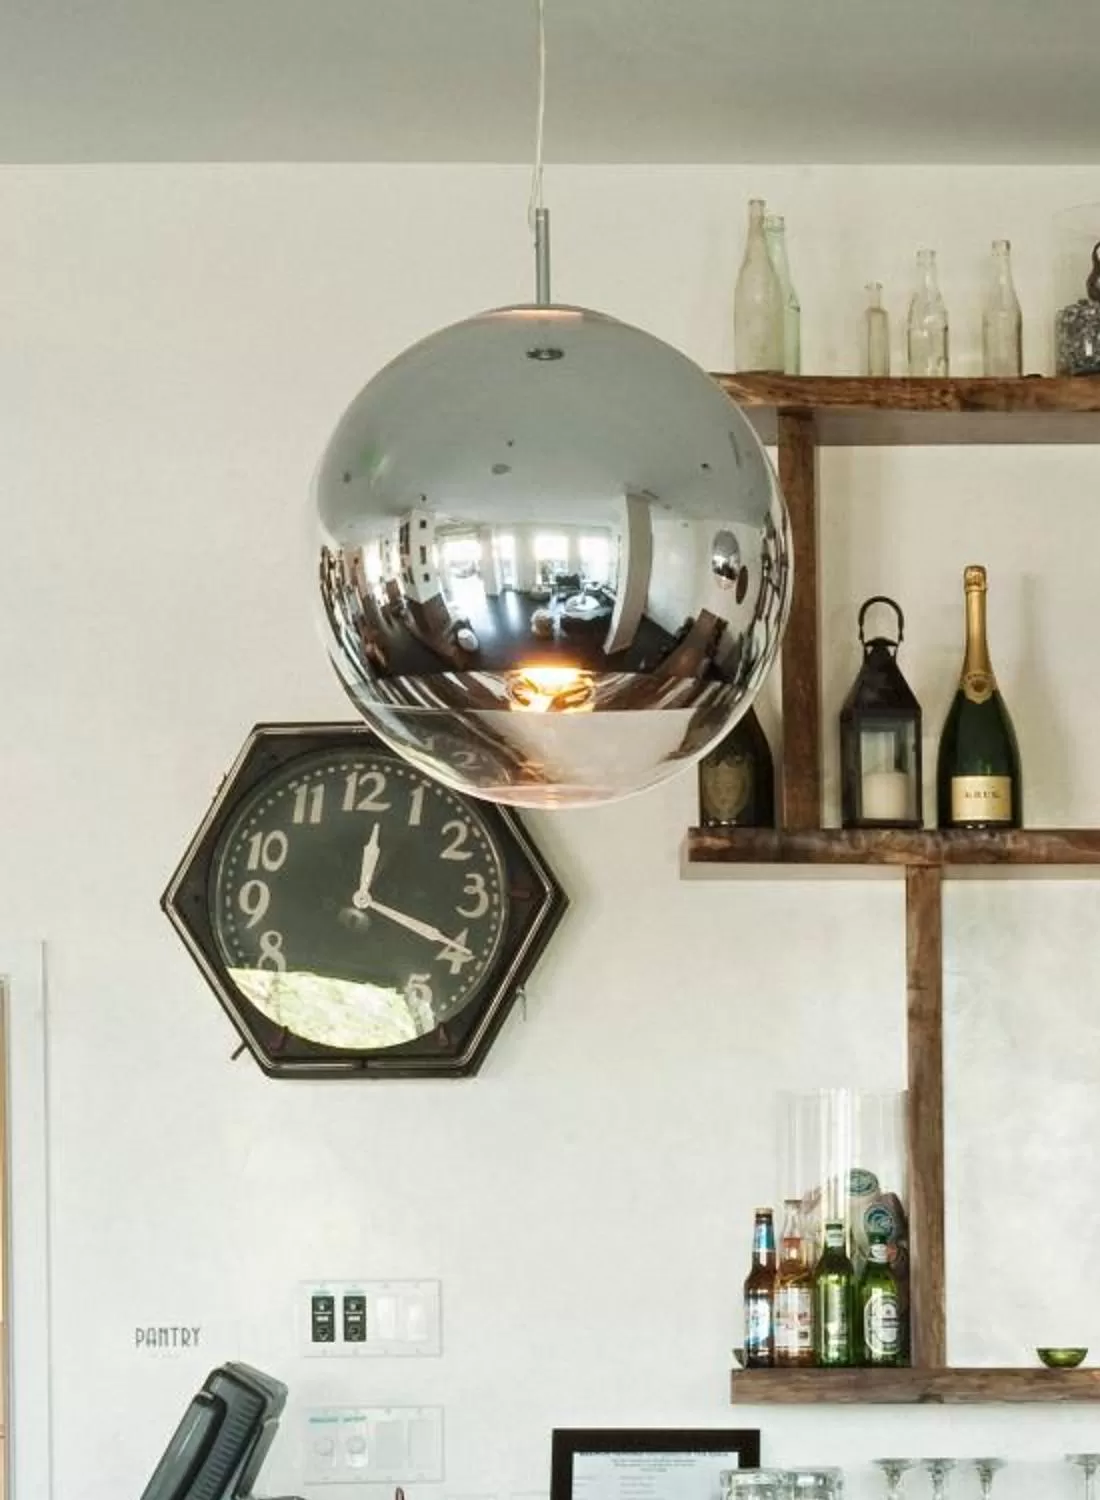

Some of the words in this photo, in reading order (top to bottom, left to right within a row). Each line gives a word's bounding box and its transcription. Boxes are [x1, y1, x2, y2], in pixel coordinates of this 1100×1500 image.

[292, 783, 325, 825] 11
[341, 770, 392, 812] 12
[407, 784, 425, 827] 1
[247, 829, 289, 873] 10
[439, 819, 475, 861] 2
[238, 879, 270, 930] 9
[455, 872, 489, 919] 3
[434, 927, 477, 975] 4
[135, 1326, 201, 1348] PANTRY
